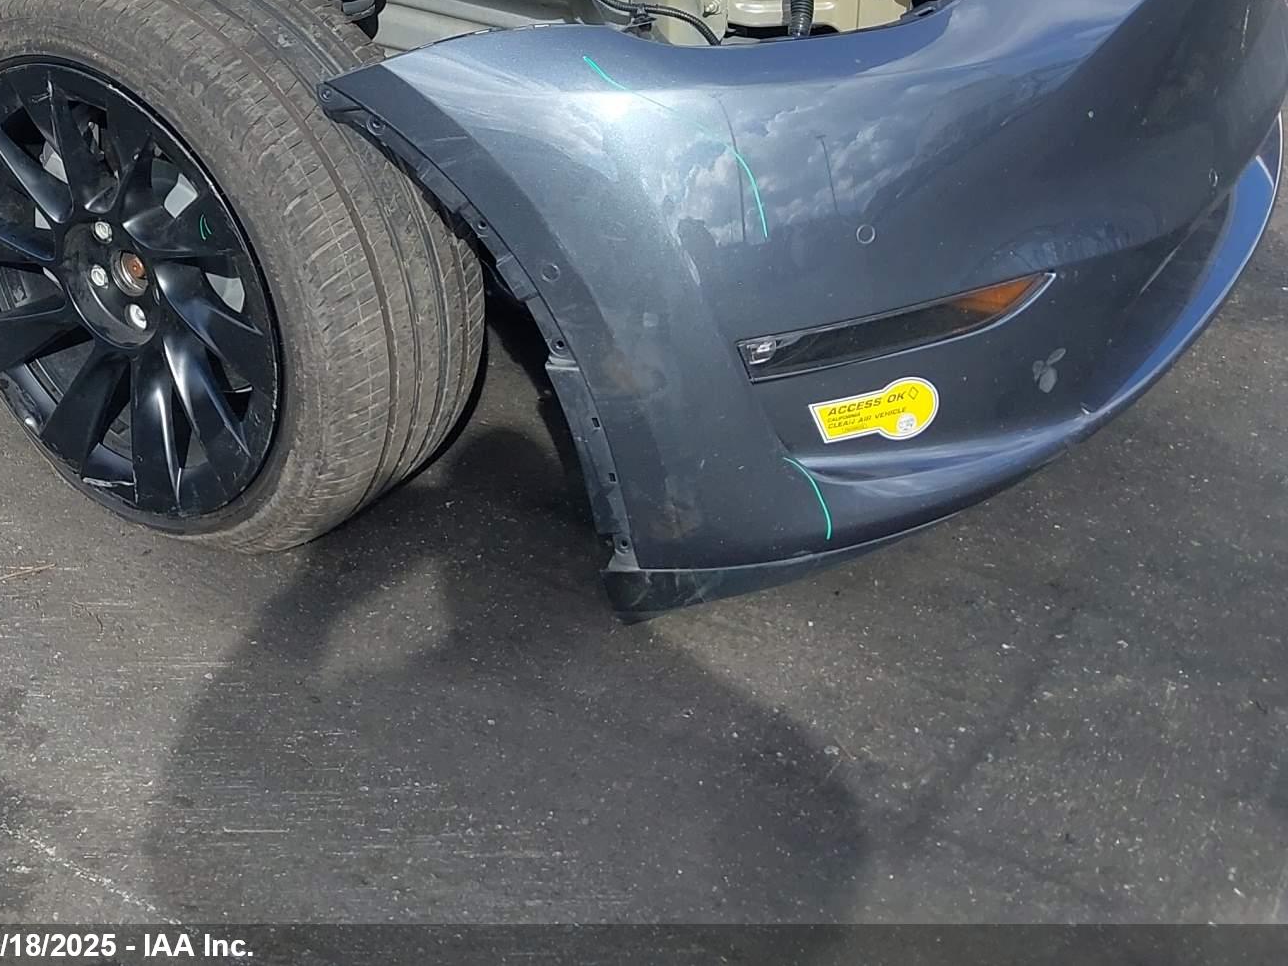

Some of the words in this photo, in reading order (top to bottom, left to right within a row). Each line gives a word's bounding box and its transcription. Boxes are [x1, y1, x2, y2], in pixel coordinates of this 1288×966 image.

[827, 397, 883, 417] ACCESS
[887, 391, 907, 404] OK
[827, 418, 856, 429] CLEAN
[858, 415, 872, 423] AIR
[875, 407, 907, 420] VEHICLE
